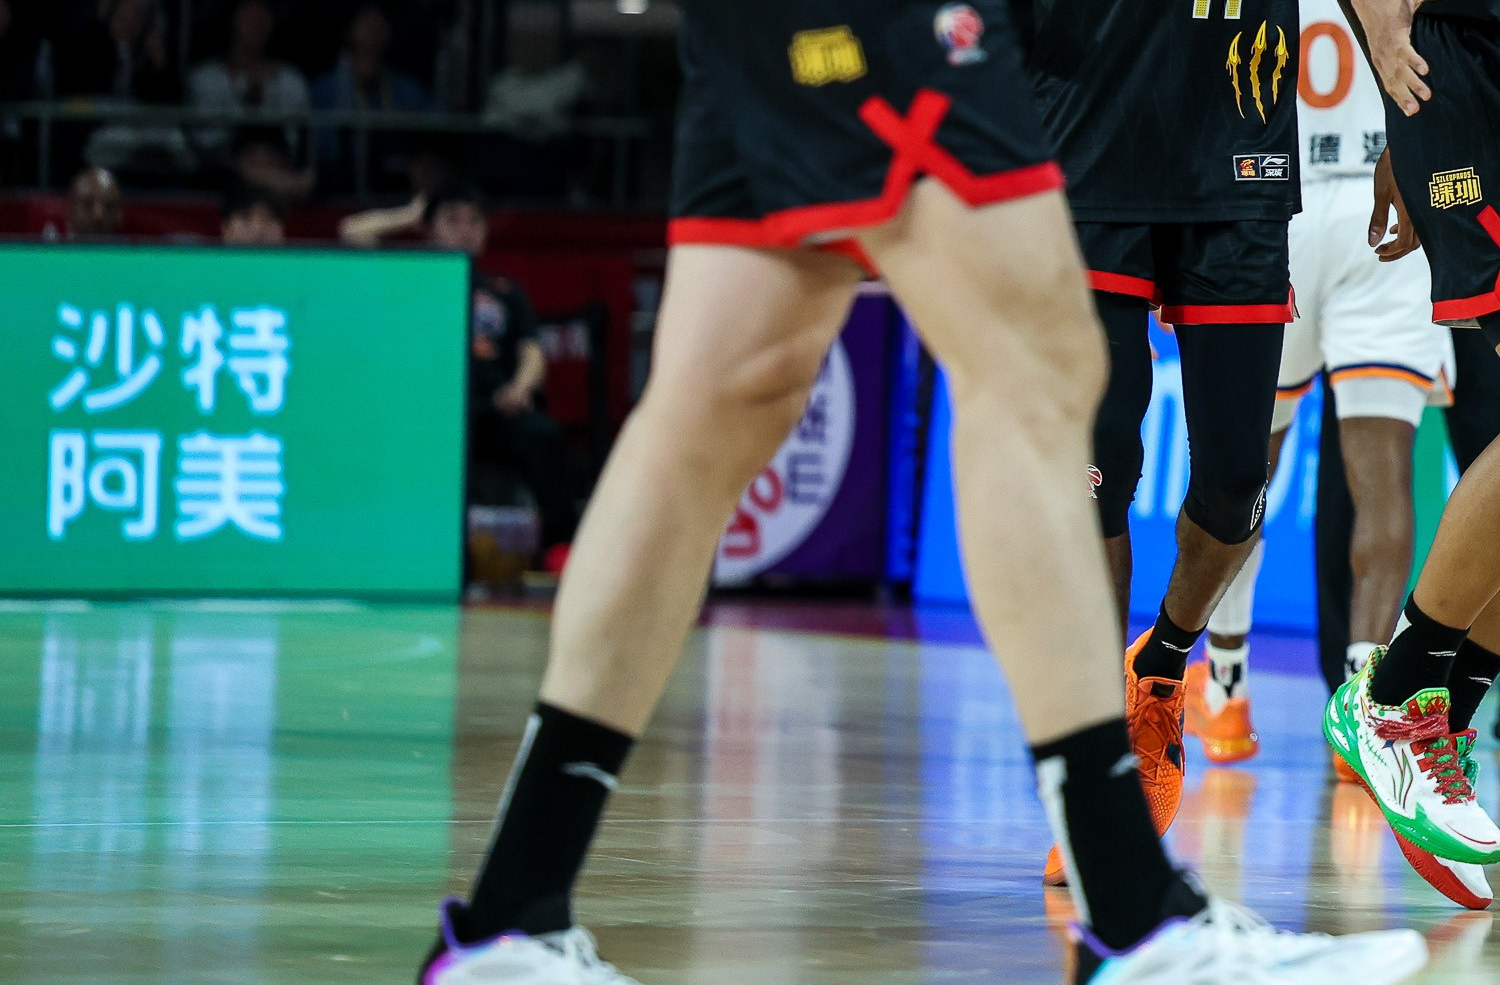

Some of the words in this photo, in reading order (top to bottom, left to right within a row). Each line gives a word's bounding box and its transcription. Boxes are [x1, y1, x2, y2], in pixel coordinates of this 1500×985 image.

[1432, 178, 1479, 205] 深圳
[48, 302, 290, 412] 沙特
[46, 431, 287, 542] 阿美
